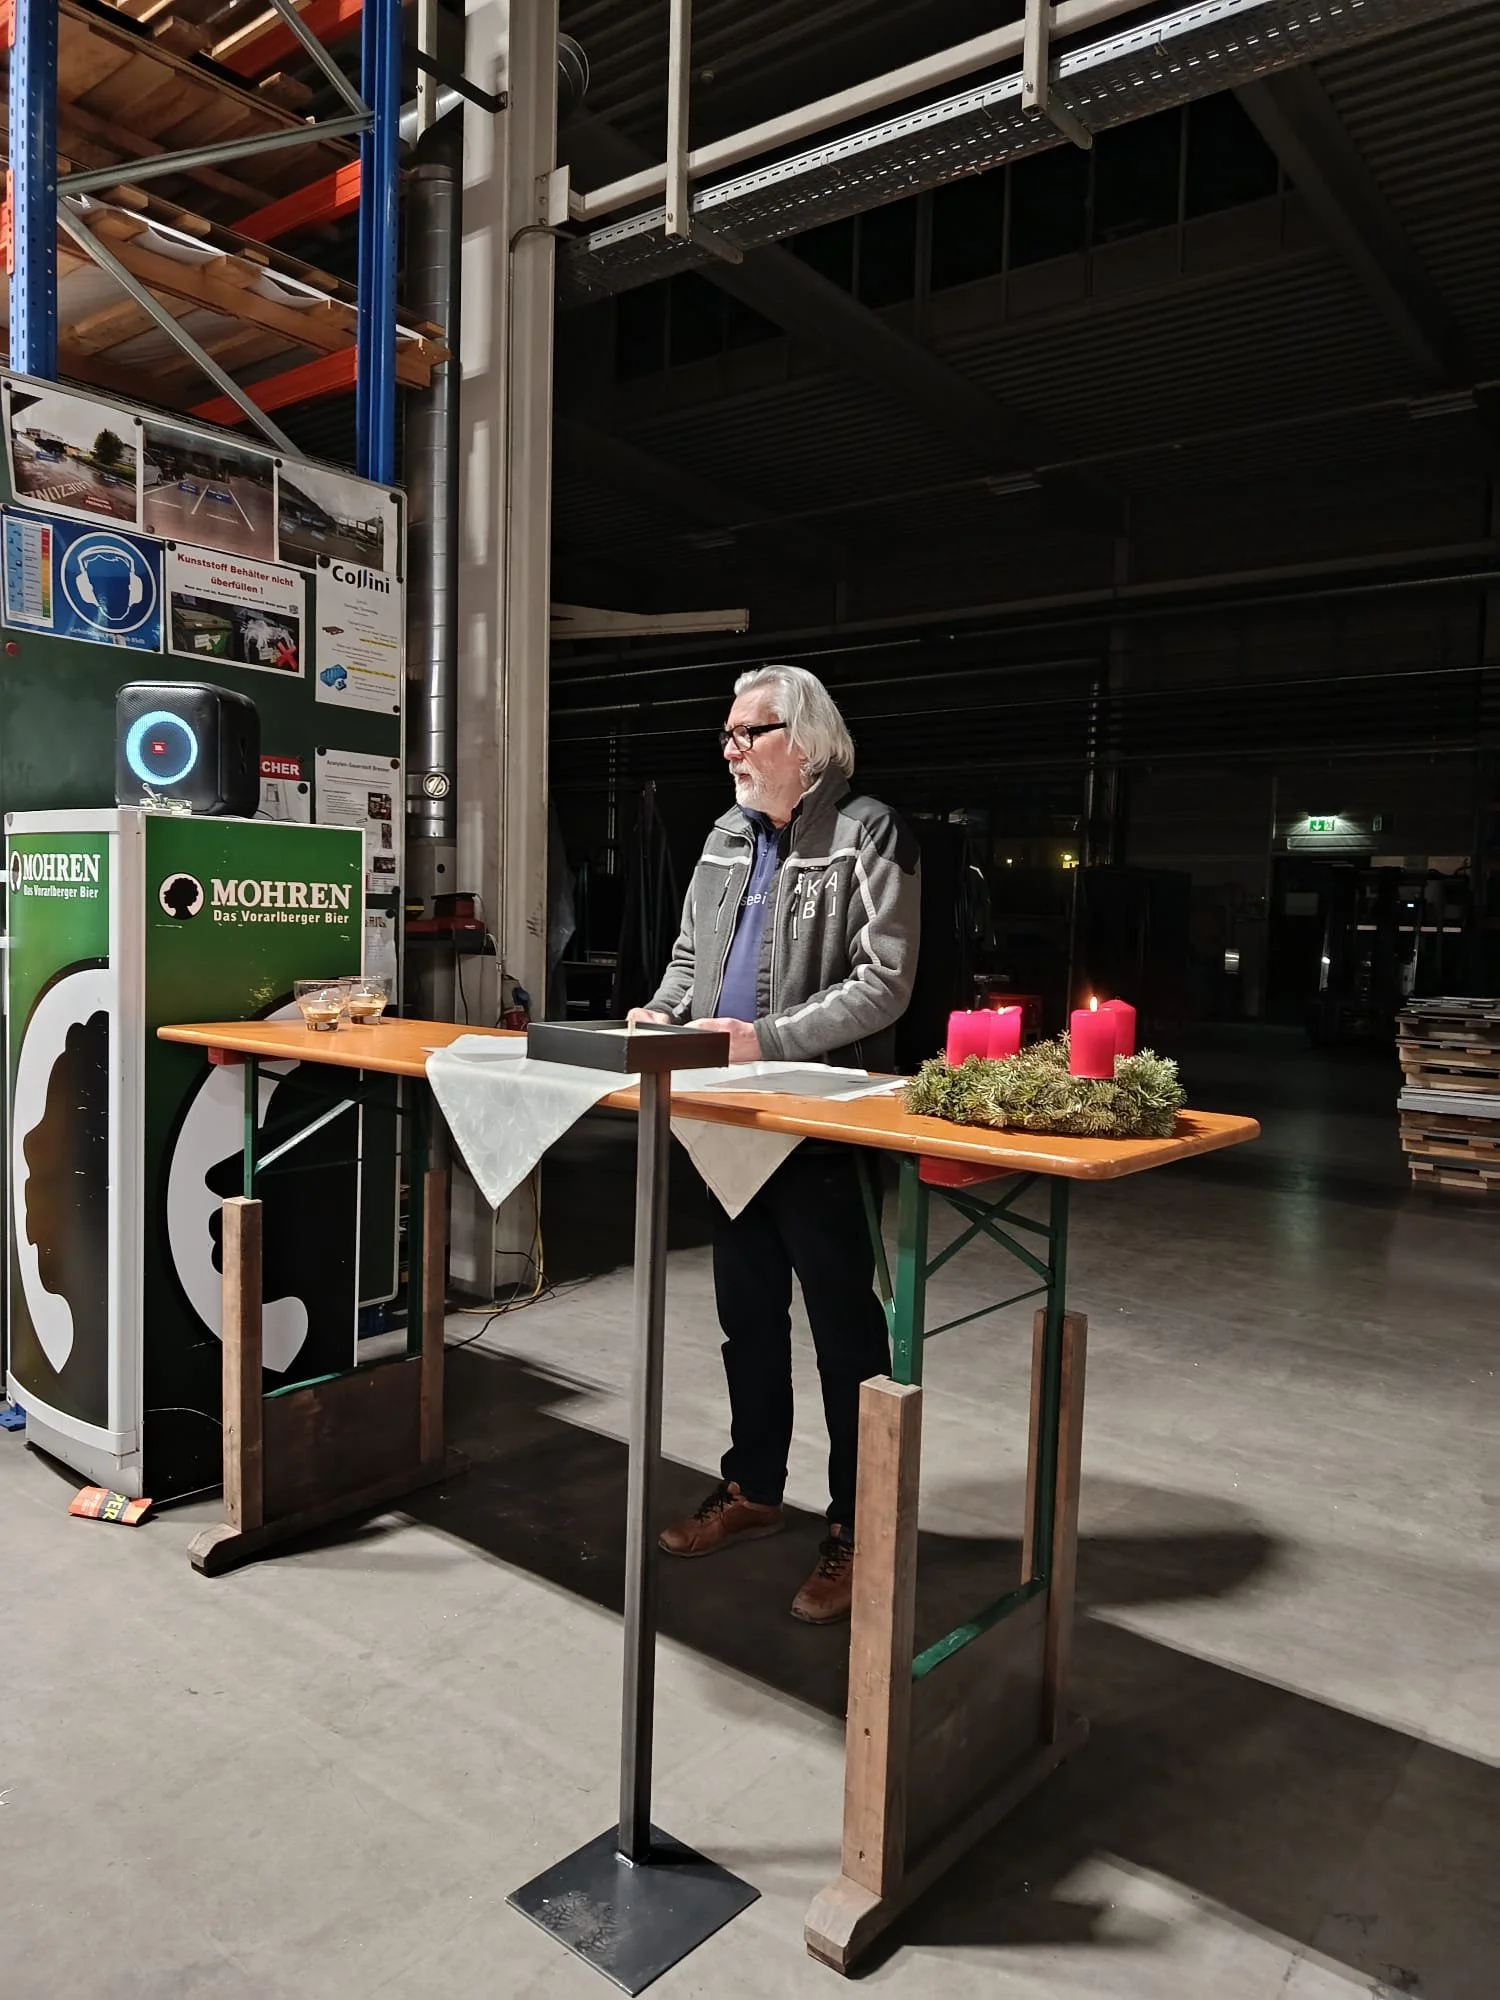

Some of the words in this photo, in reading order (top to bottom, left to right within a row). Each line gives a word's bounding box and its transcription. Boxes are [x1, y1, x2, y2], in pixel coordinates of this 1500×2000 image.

[177, 553, 228, 572] Kunststoff
[230, 565, 269, 581] Behälter
[272, 575, 294, 587] nicht
[332, 565, 390, 594] Collini
[211, 577, 258, 593] überfüllen
[261, 761, 300, 775] CHER
[22, 853, 101, 882] MOHREN
[23, 884, 33, 896] Das
[33, 885, 77, 899] Vorarlberger
[79, 886, 99, 898] Bier
[210, 878, 352, 910] MOHREN
[213, 910, 237, 922] Das
[241, 910, 320, 925] Vorarlberger
[325, 912, 349, 924] Bier
